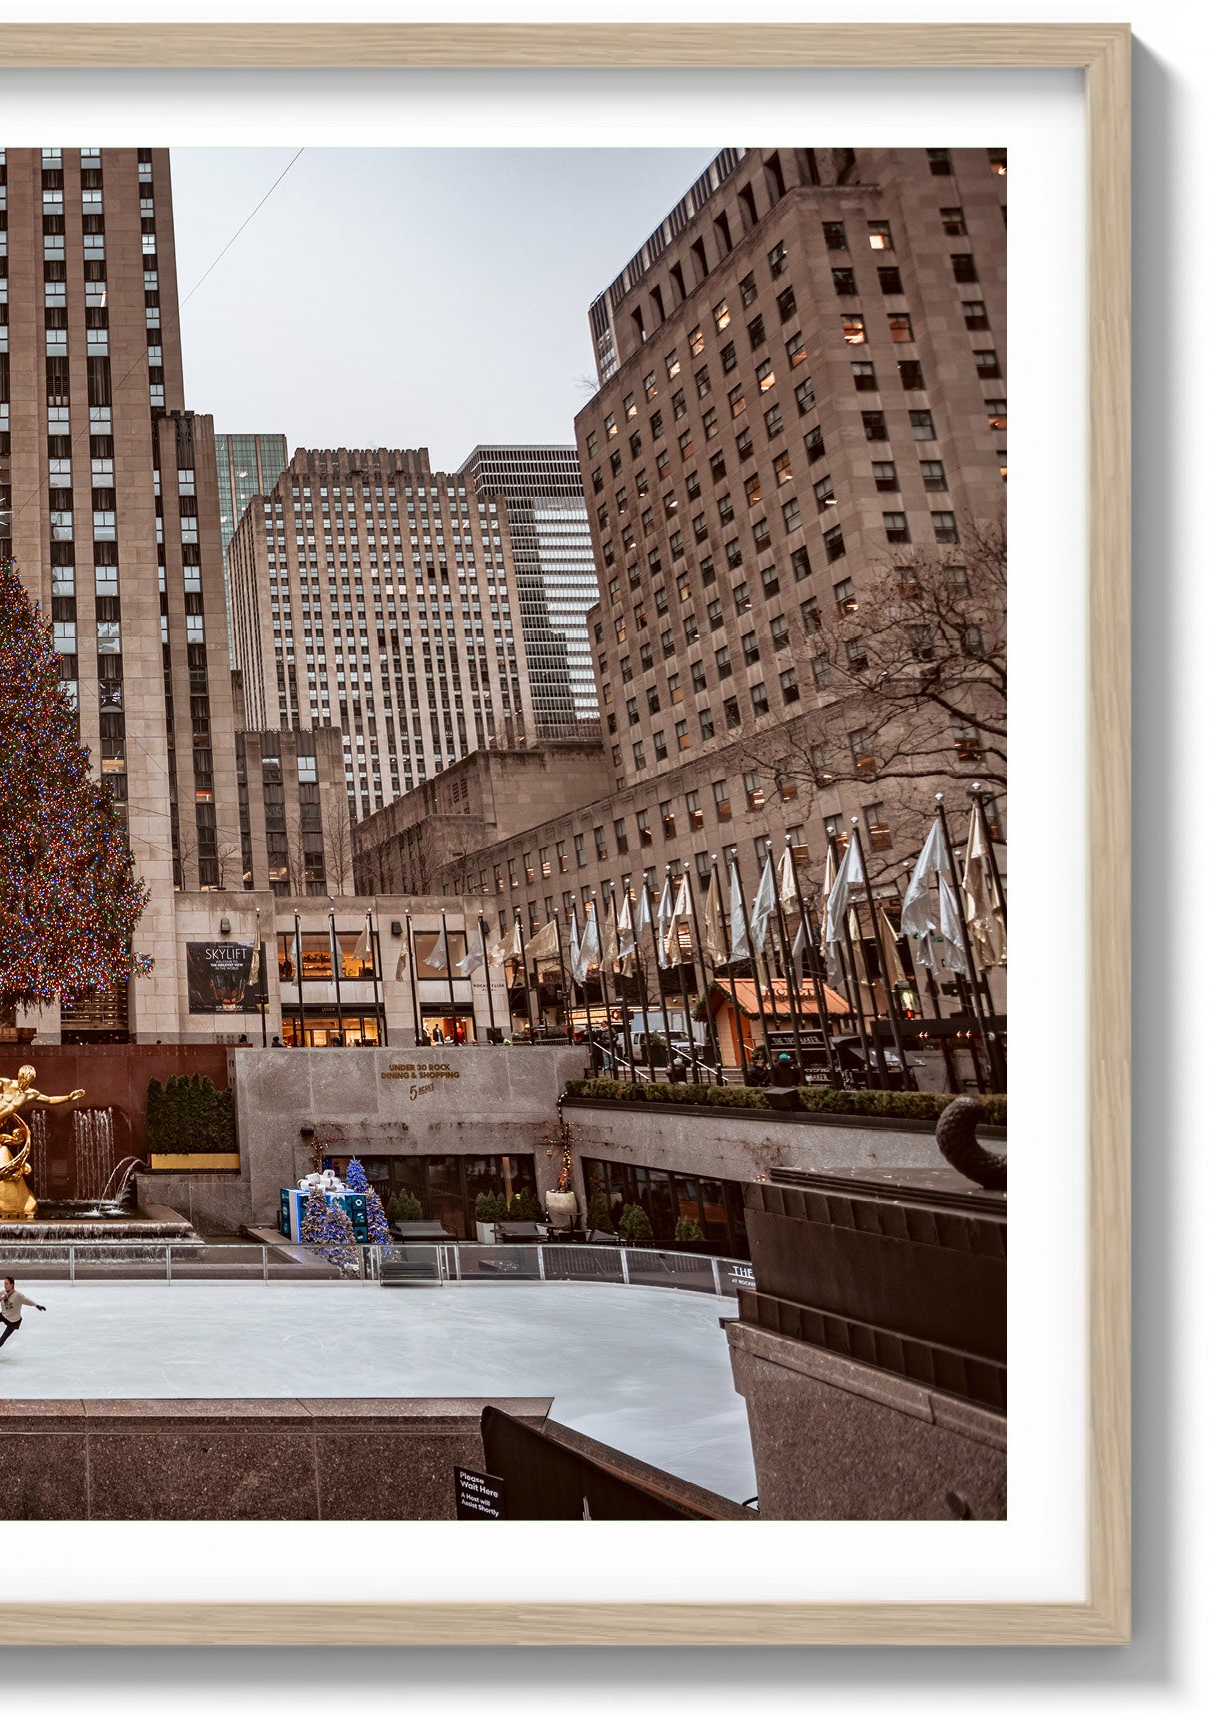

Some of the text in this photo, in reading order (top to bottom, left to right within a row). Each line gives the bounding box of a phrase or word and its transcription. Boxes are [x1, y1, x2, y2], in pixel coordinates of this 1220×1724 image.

[205, 948, 247, 960] SKYLIFT
[419, 1071, 460, 1079] SHOPPING
[409, 1083, 435, 1101] 5 ACRES
[732, 1266, 753, 1278] THE
[460, 1471, 484, 1484] Please
[460, 1480, 499, 1498] Wait Here
[466, 1493, 479, 1503] Host
[461, 1499, 499, 1517] Assist Shortly
